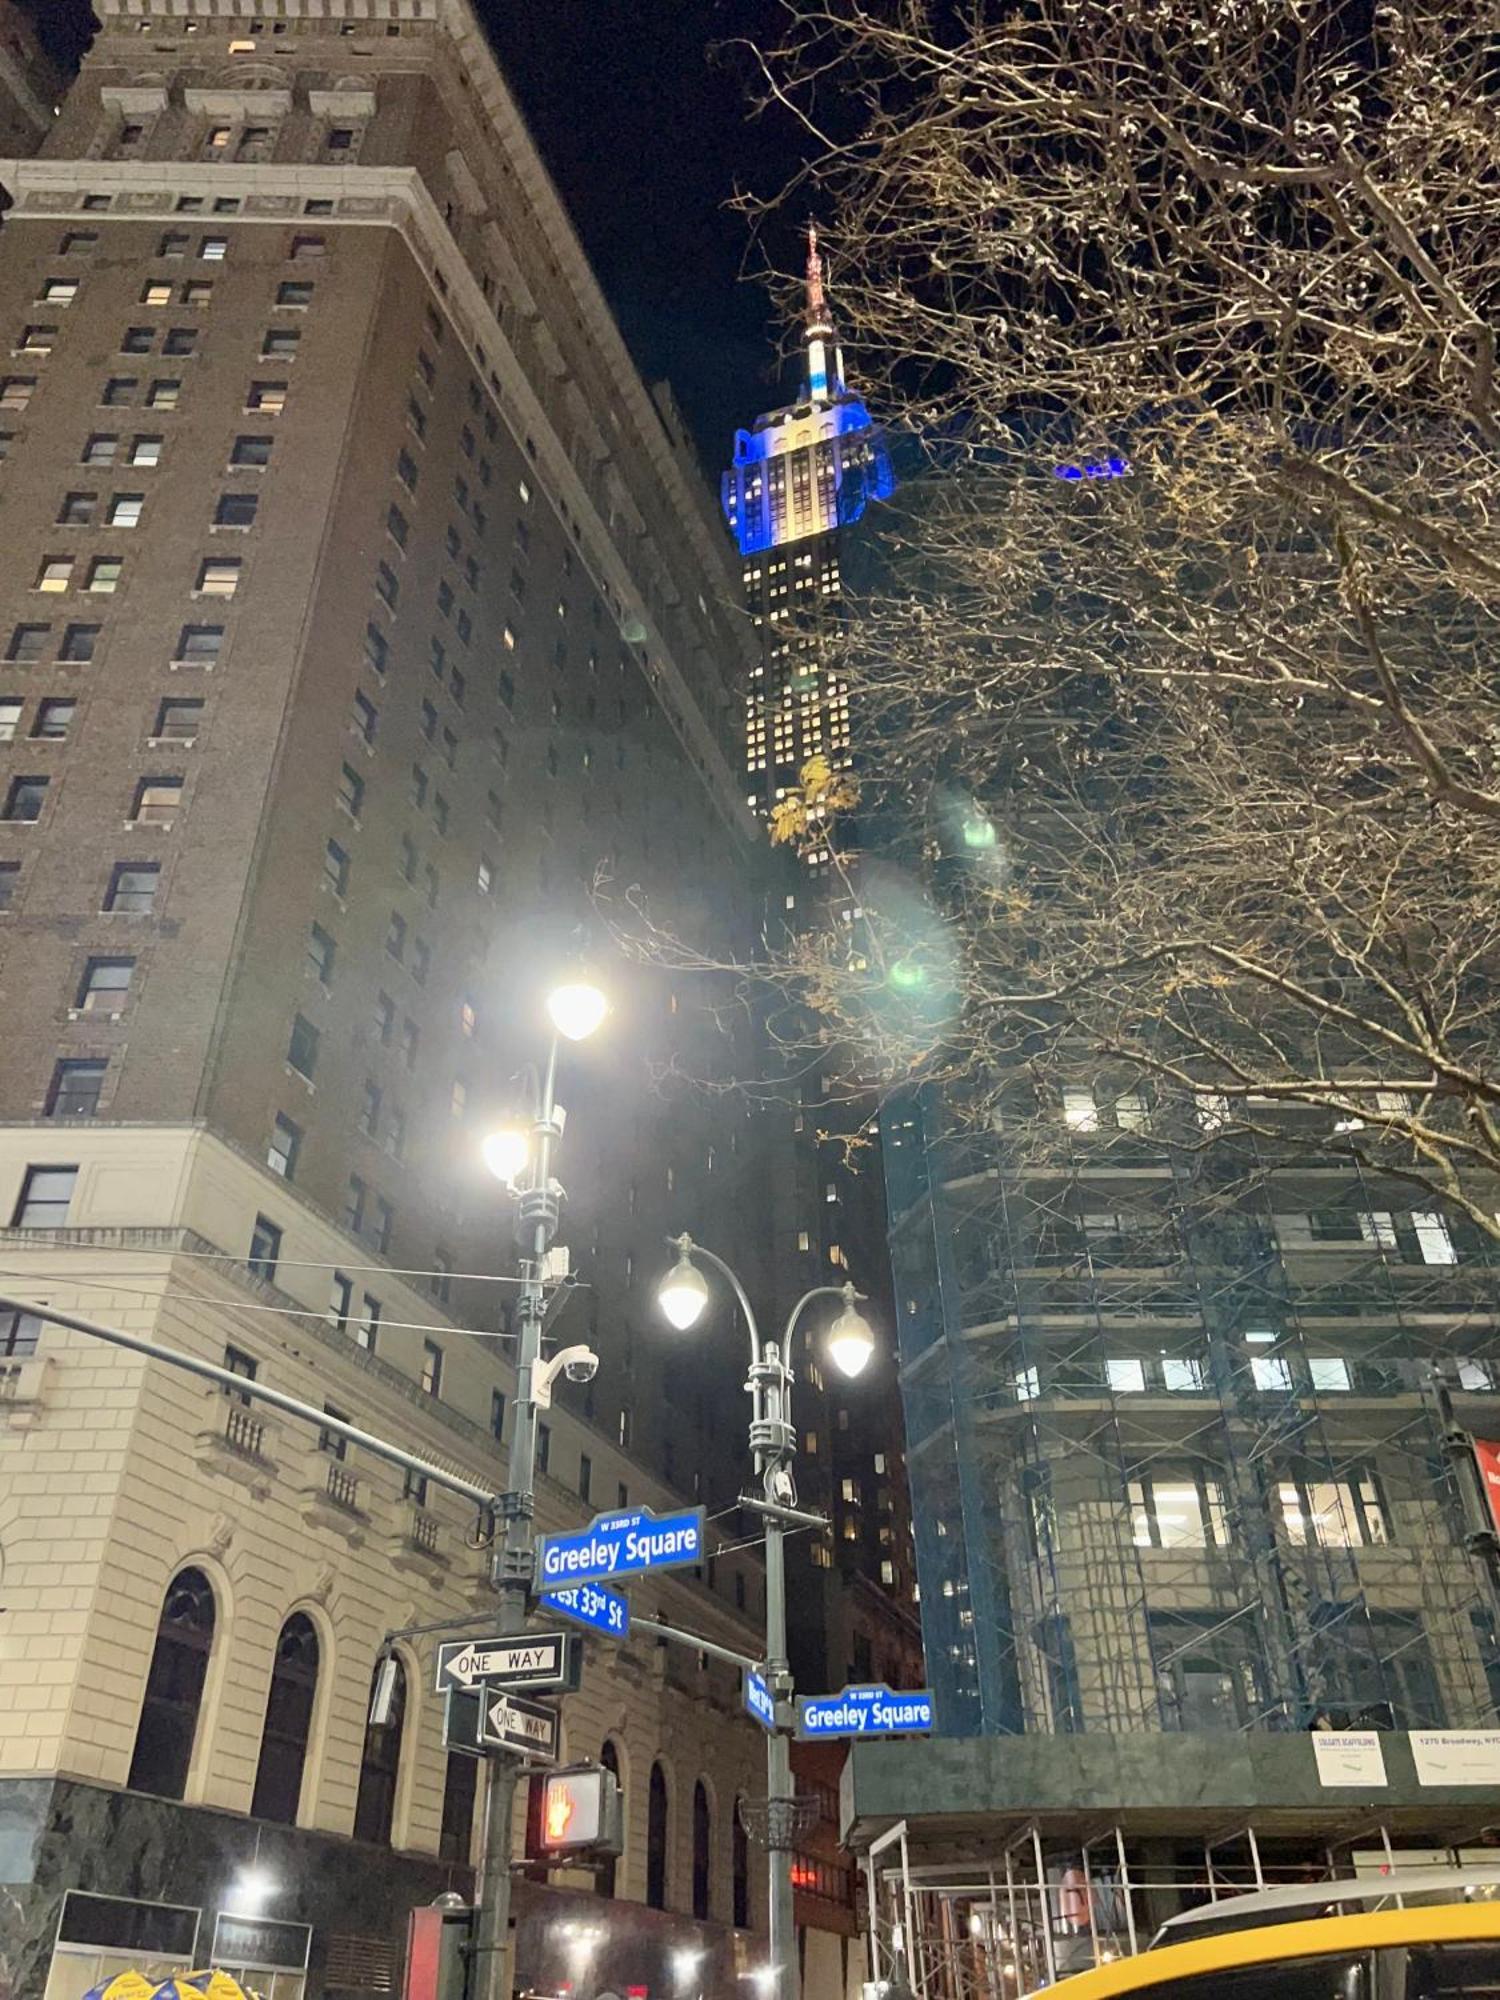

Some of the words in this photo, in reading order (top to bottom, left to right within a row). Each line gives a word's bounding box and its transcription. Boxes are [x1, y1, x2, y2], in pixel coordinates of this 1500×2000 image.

[601, 1523, 609, 1532] W
[610, 1518, 629, 1531] 33RD
[631, 1516, 641, 1526] ST
[545, 1538, 620, 1572] Greeley
[626, 1527, 697, 1565] Square
[550, 1588, 579, 1609] est
[581, 1587, 606, 1617] 33rd
[608, 1600, 623, 1628] St
[458, 1654, 491, 1674] ONE
[508, 1649, 544, 1669] WAY
[496, 1707, 516, 1730] ONE
[526, 1720, 546, 1740] WAY
[805, 1703, 867, 1731] Greeley
[872, 1702, 930, 1728] Square
